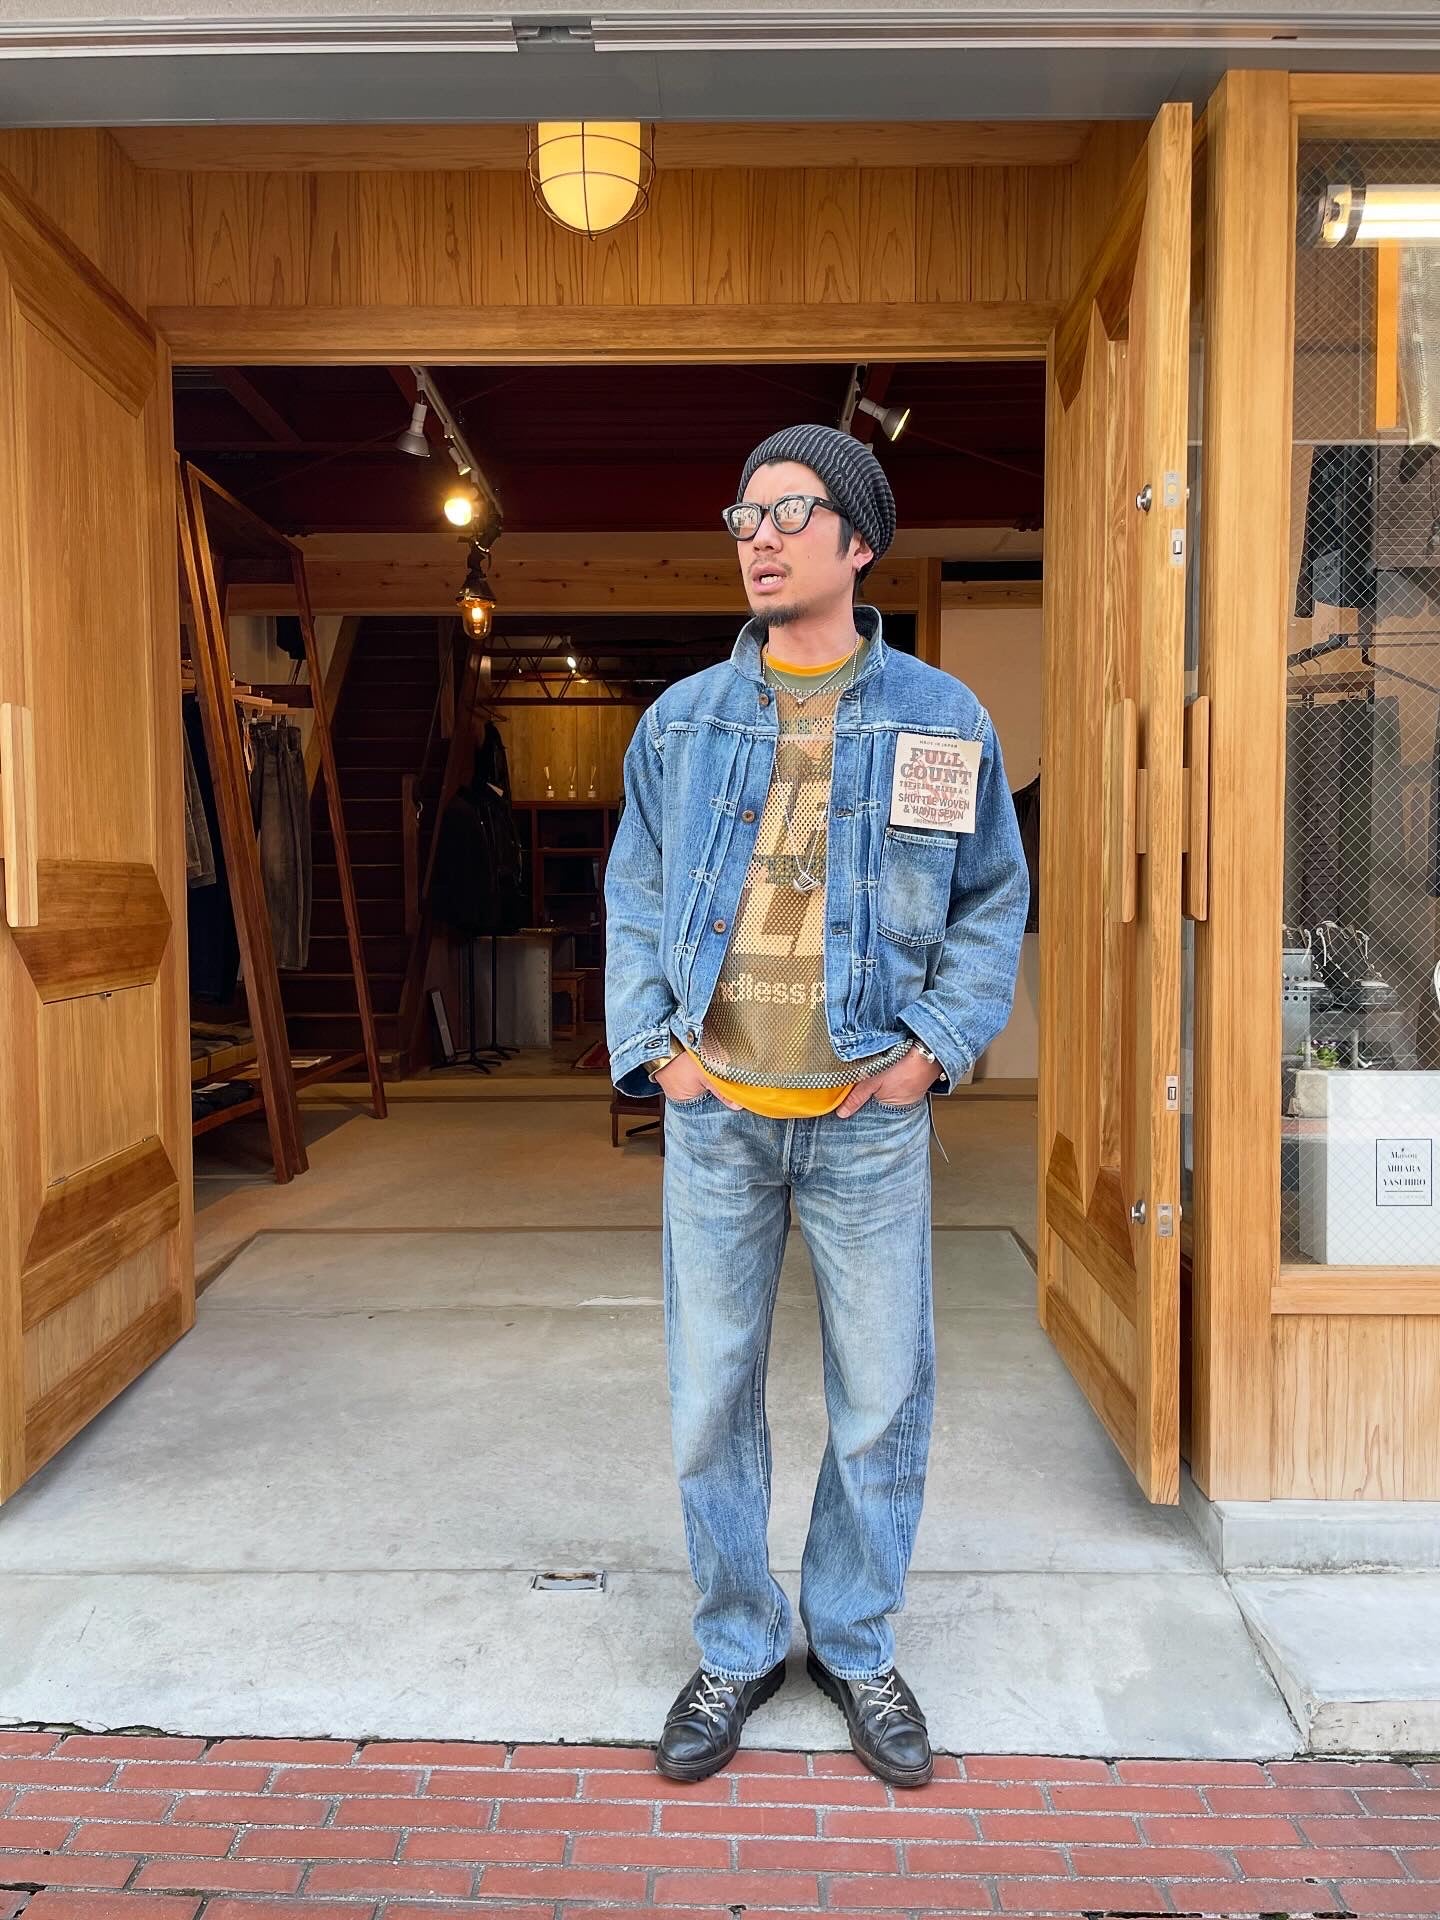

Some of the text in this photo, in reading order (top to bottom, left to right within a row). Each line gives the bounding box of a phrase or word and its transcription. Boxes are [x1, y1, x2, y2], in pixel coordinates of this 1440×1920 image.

[910, 748, 964, 767] FULL
[900, 763, 972, 785] COUNT
[898, 793, 970, 810] SHUTTLE WOVEN
[904, 804, 964, 820] & HAND SEWN
